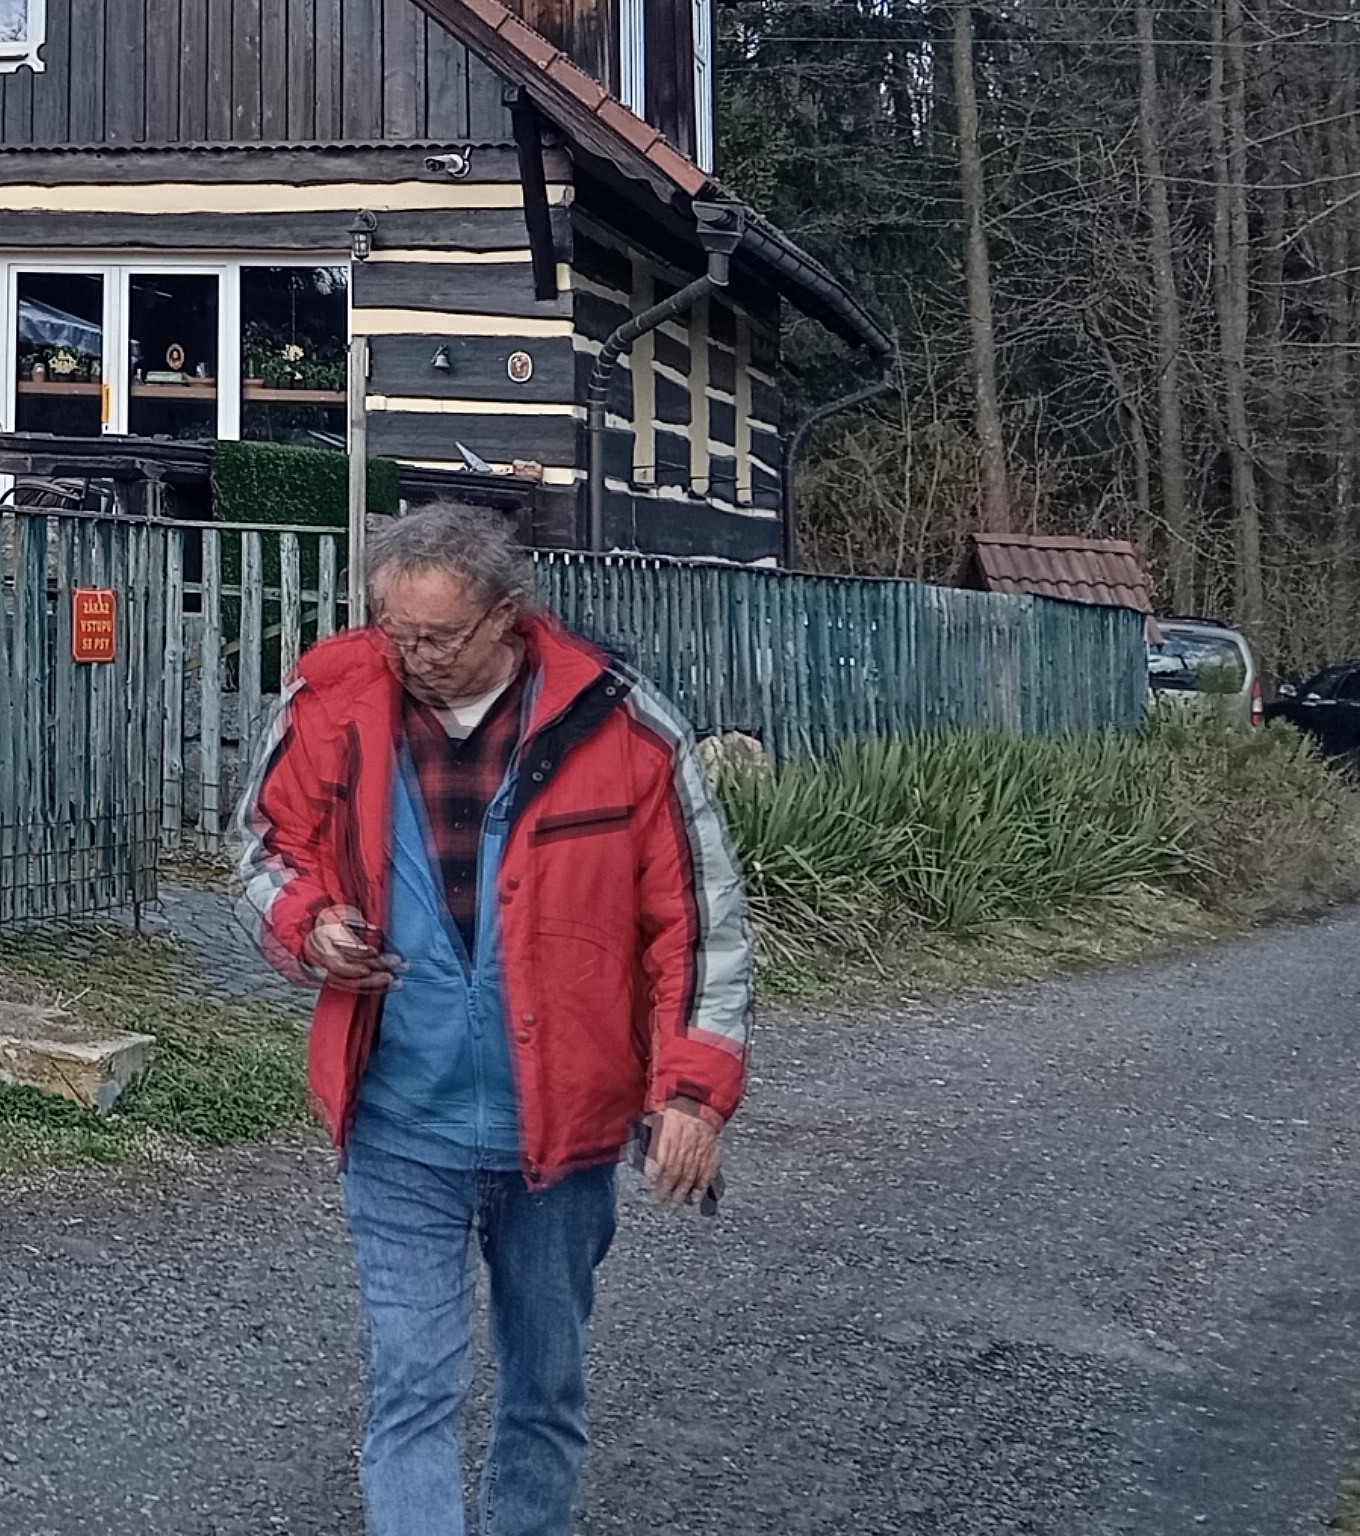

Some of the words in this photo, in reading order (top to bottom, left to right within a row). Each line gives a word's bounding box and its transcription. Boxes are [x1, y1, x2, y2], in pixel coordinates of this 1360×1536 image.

[83, 598, 110, 614] ZÁKAZ
[80, 620, 112, 633] VSTUPU
[82, 637, 92, 651] SE
[94, 637, 110, 651] PSY
